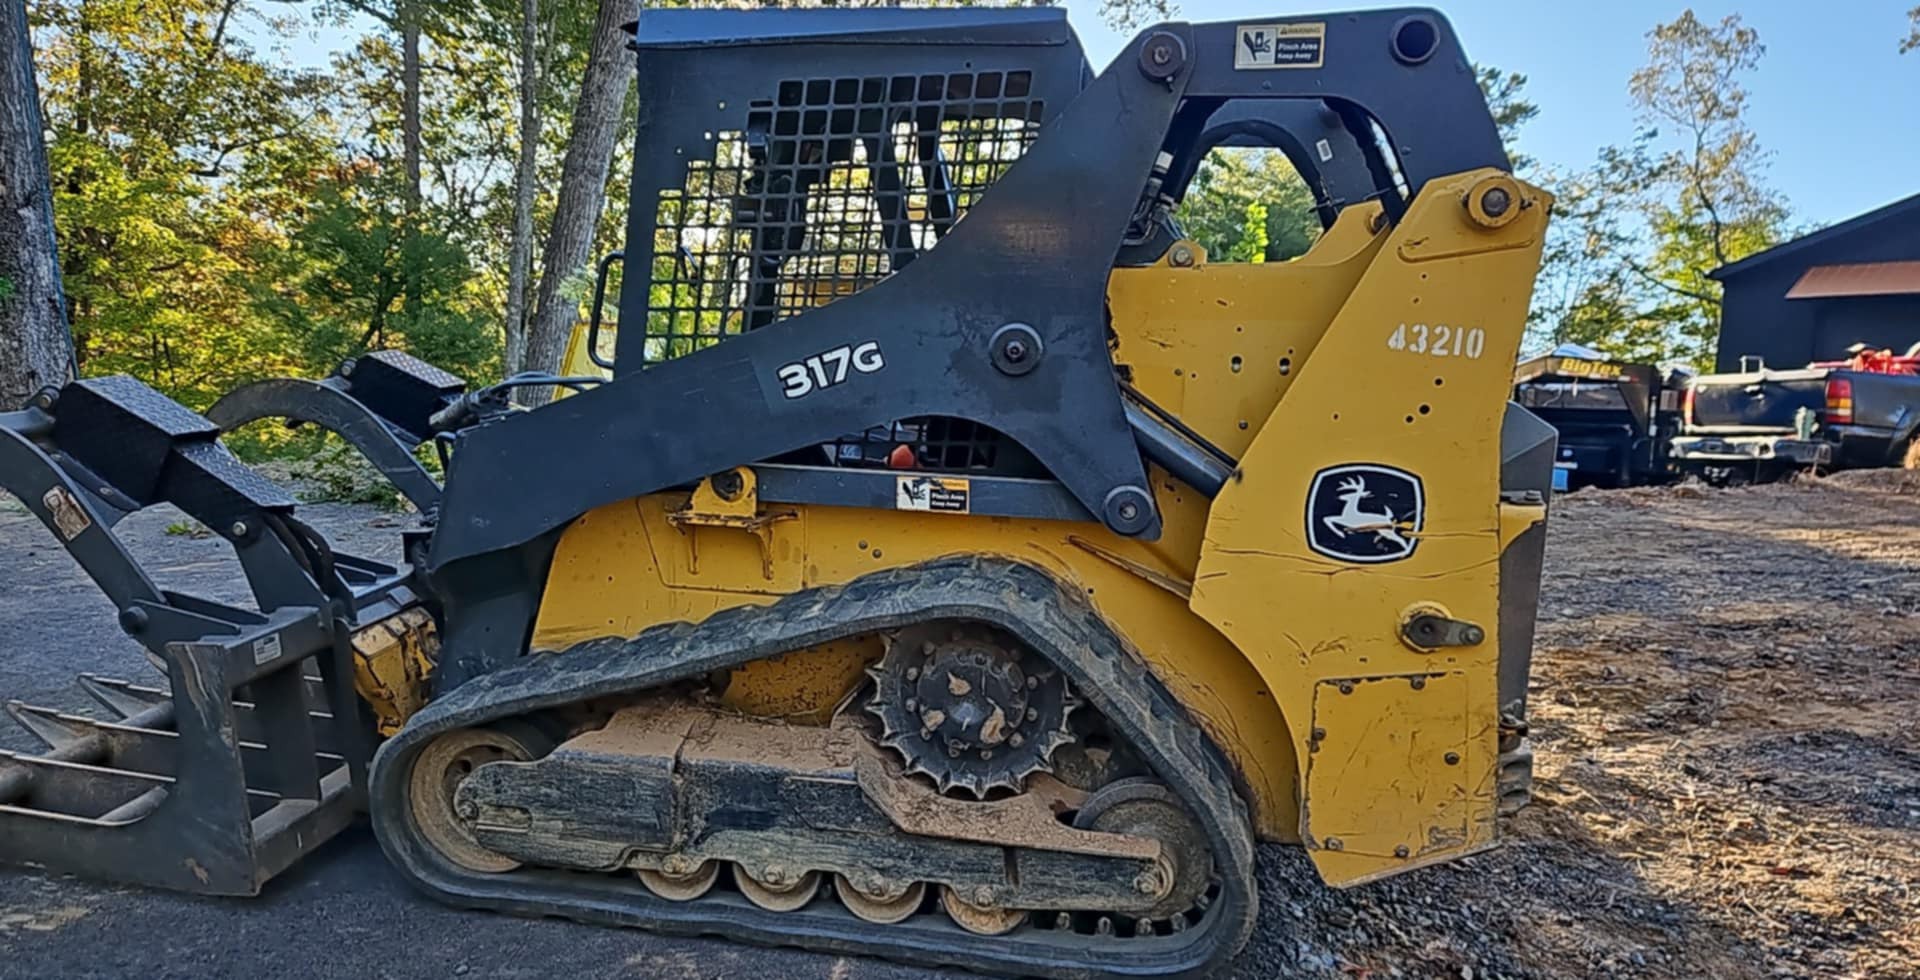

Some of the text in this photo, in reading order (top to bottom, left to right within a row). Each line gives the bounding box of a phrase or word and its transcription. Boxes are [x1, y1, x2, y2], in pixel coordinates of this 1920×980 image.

[1300, 42, 1318, 50] Area
[1387, 323, 1485, 359] 43210
[777, 341, 885, 398] 317G
